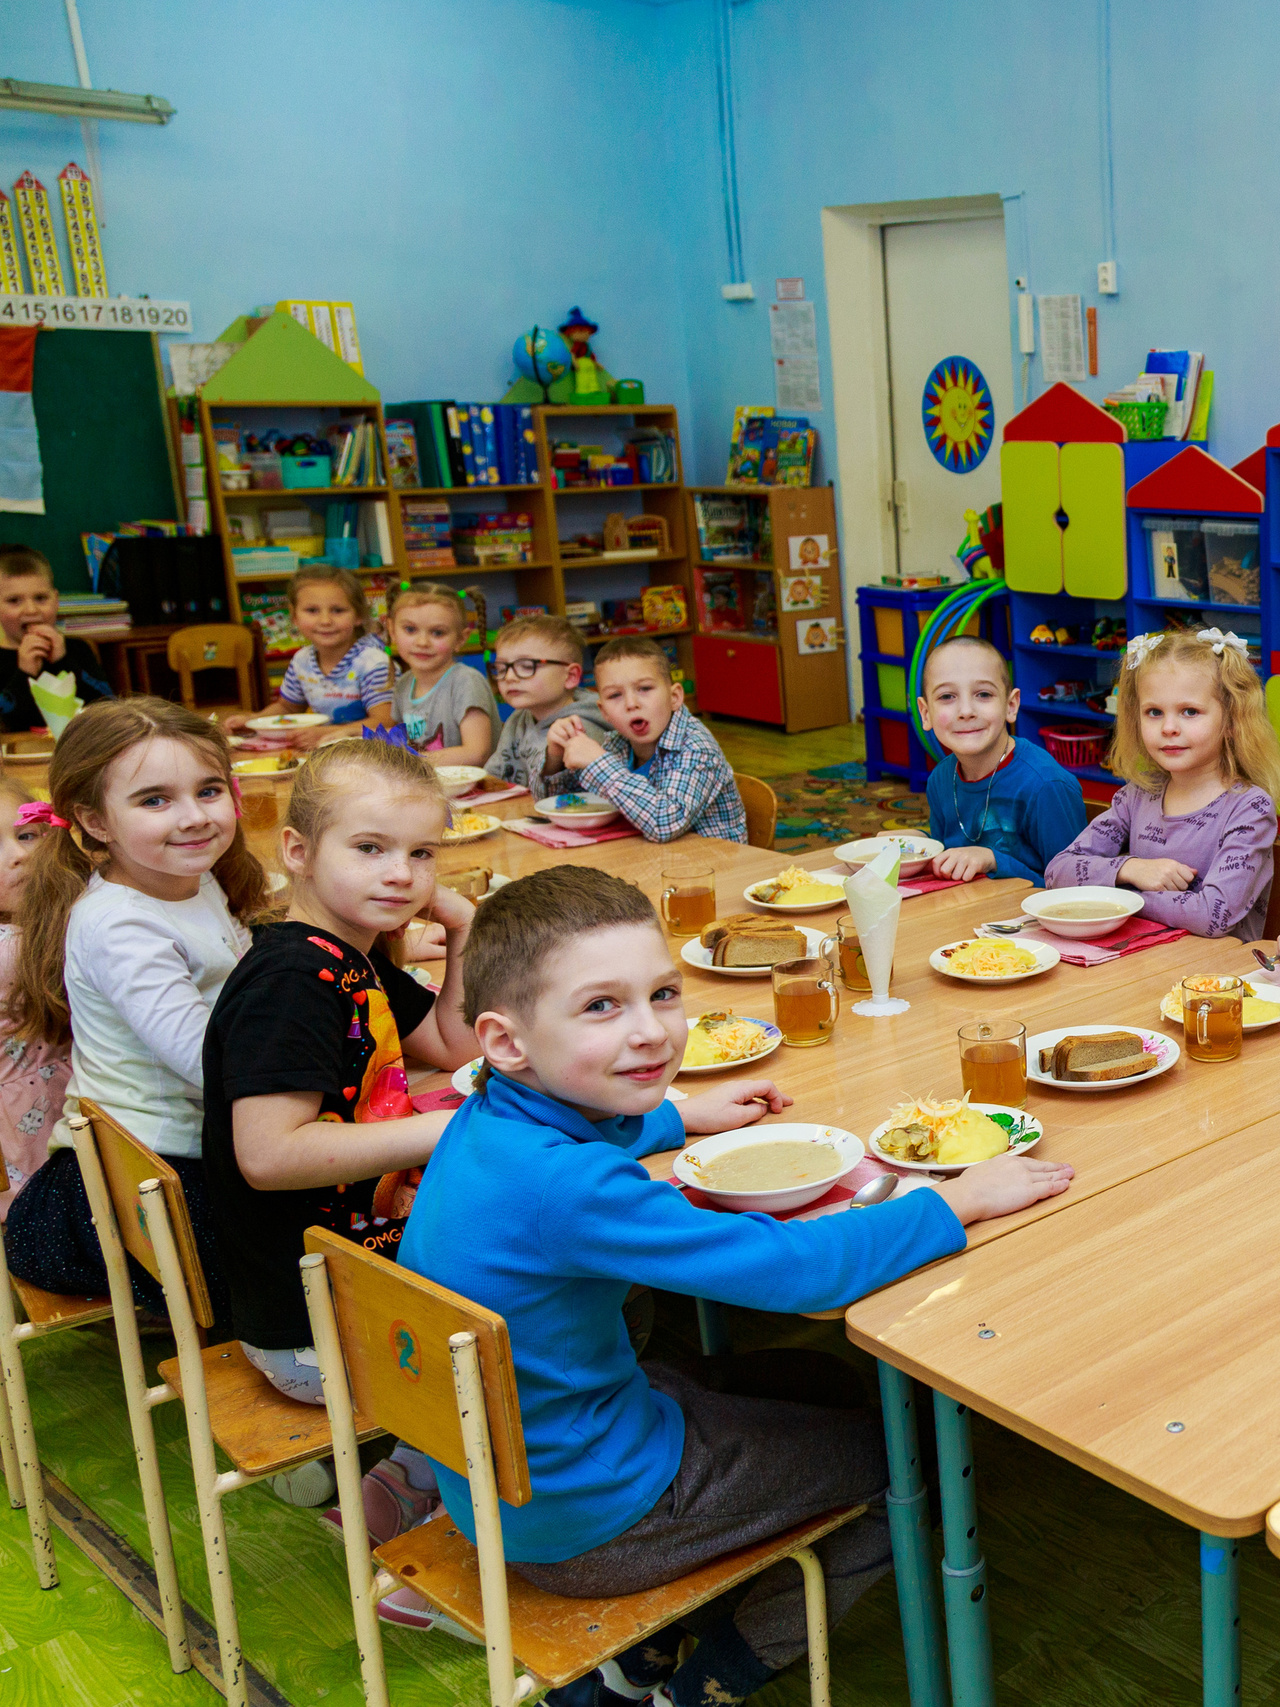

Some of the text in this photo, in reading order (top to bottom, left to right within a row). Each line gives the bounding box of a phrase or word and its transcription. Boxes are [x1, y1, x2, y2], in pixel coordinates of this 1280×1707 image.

[2, 302, 188, 327] 4 15 16 17 18 19 20
